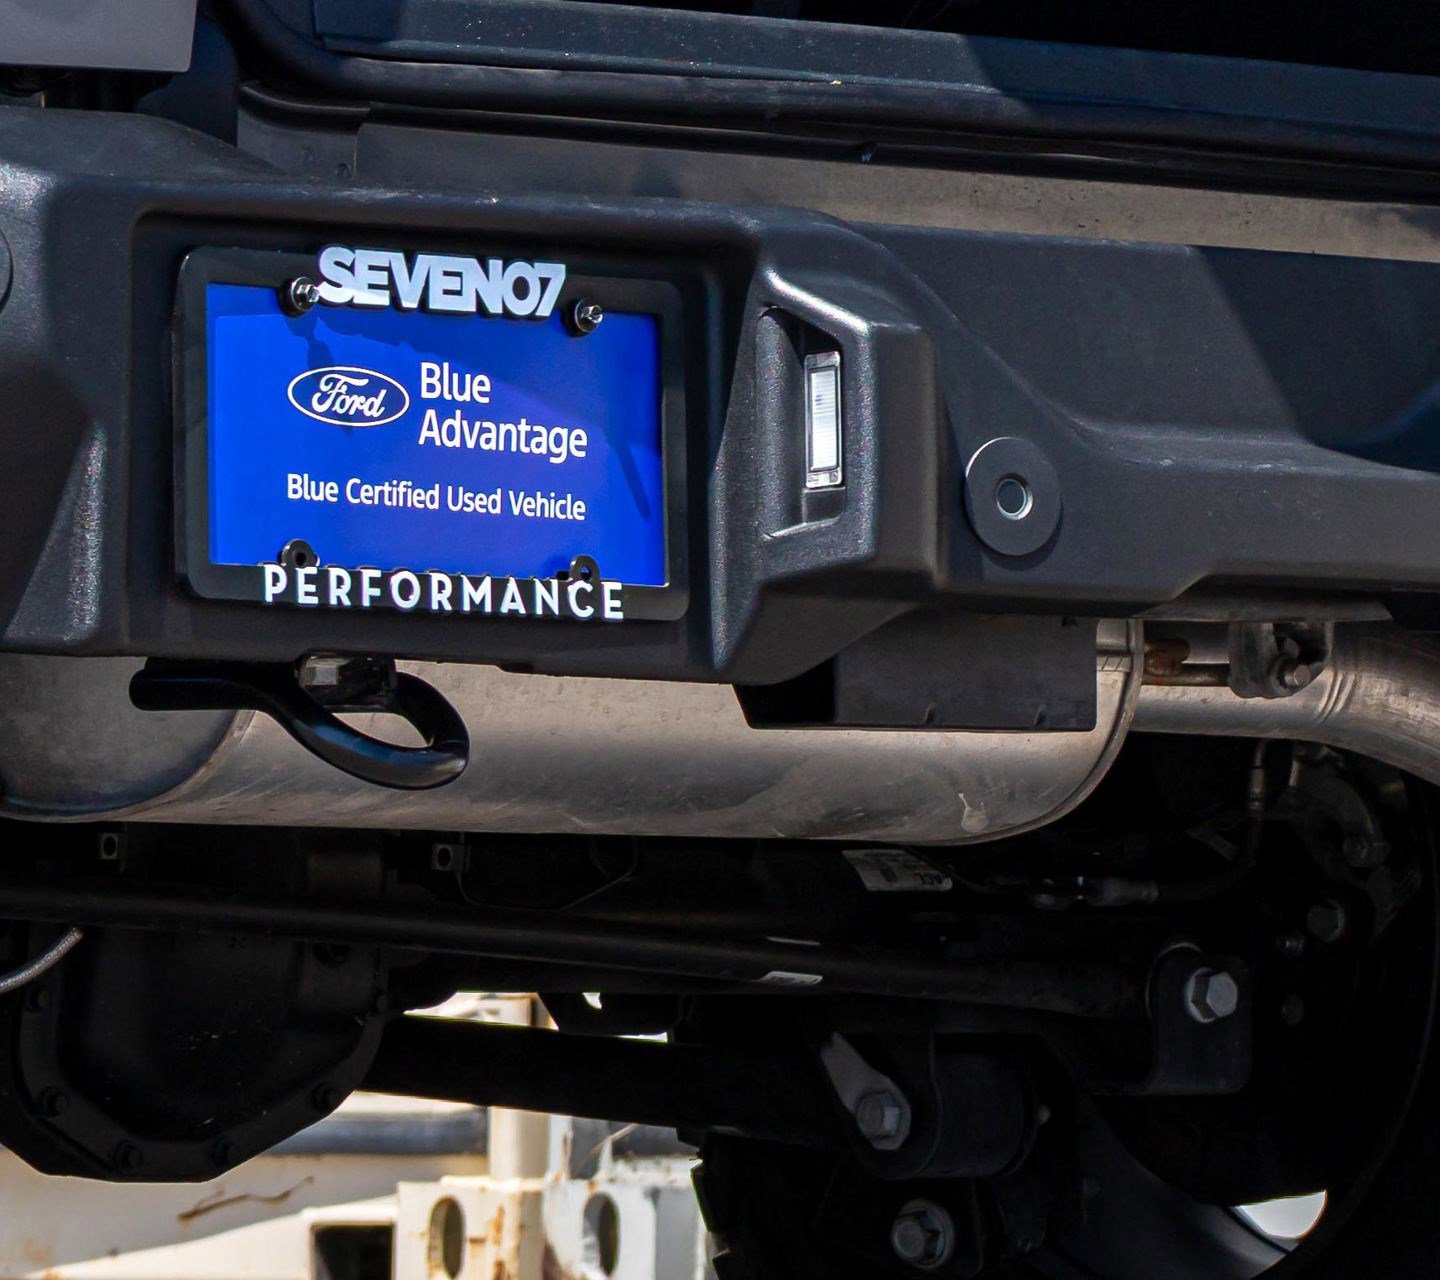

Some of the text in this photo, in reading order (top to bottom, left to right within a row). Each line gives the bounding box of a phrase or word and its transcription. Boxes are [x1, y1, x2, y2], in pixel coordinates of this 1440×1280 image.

[308, 370, 391, 420] Ford
[419, 361, 491, 404] Blue
[418, 408, 588, 465] Advantage
[287, 473, 586, 521] Blue Certified Used Vehicle
[263, 563, 625, 620] PERFORMANCE
